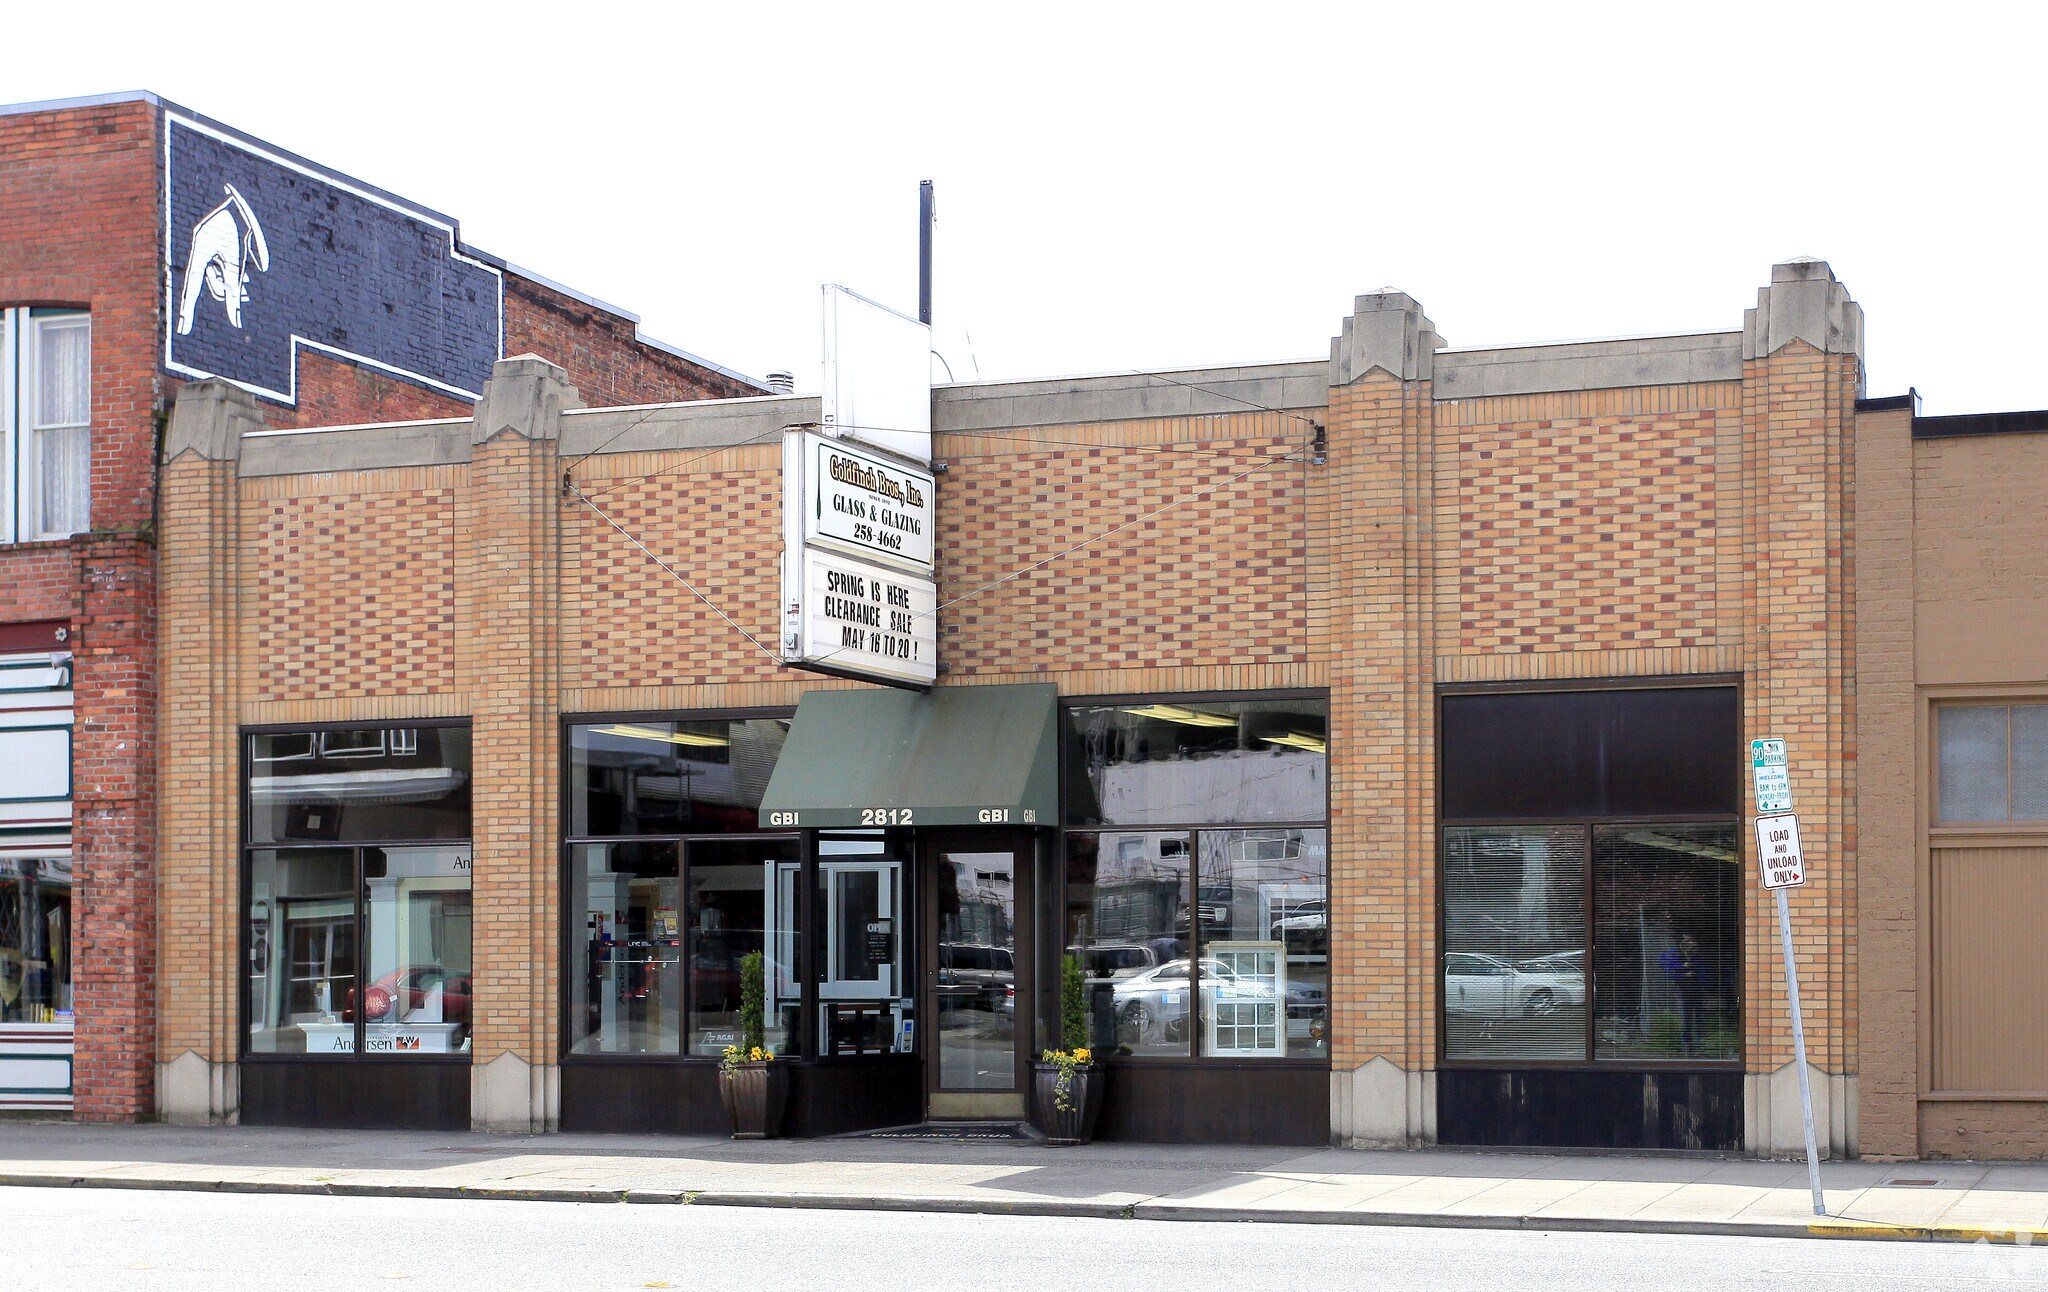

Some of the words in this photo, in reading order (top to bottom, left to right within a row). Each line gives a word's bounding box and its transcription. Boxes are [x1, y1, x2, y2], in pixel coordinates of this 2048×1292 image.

[829, 454, 877, 492] Goldfinch
[877, 469, 905, 508] Bros.,
[905, 479, 924, 508] Inc.
[833, 493, 865, 519] GLASS
[869, 506, 878, 522] &
[881, 508, 921, 536] GLAZING
[853, 523, 902, 551] 258-4662
[827, 570, 864, 598] SPRING
[870, 580, 881, 602] IS
[886, 584, 910, 610] HERE
[824, 595, 881, 629] CLEARANCE
[890, 610, 912, 635] SALE
[842, 625, 866, 650] MAY
[870, 632, 880, 653] 16
[883, 635, 896, 656] TO
[897, 637, 910, 659] 20
[1753, 747, 1763, 760] 90
[1765, 754, 1785, 764] PARKING
[770, 812, 799, 826] GBI
[861, 808, 913, 826] 2812
[978, 809, 1009, 823] GBI
[1023, 809, 1036, 823] GBI
[1769, 829, 1789, 842] LOAD
[1774, 843, 1787, 853] AND
[1767, 854, 1797, 869] UNLOAD
[1773, 869, 1792, 883] ONLY
[333, 1035, 392, 1050] Anrsen
